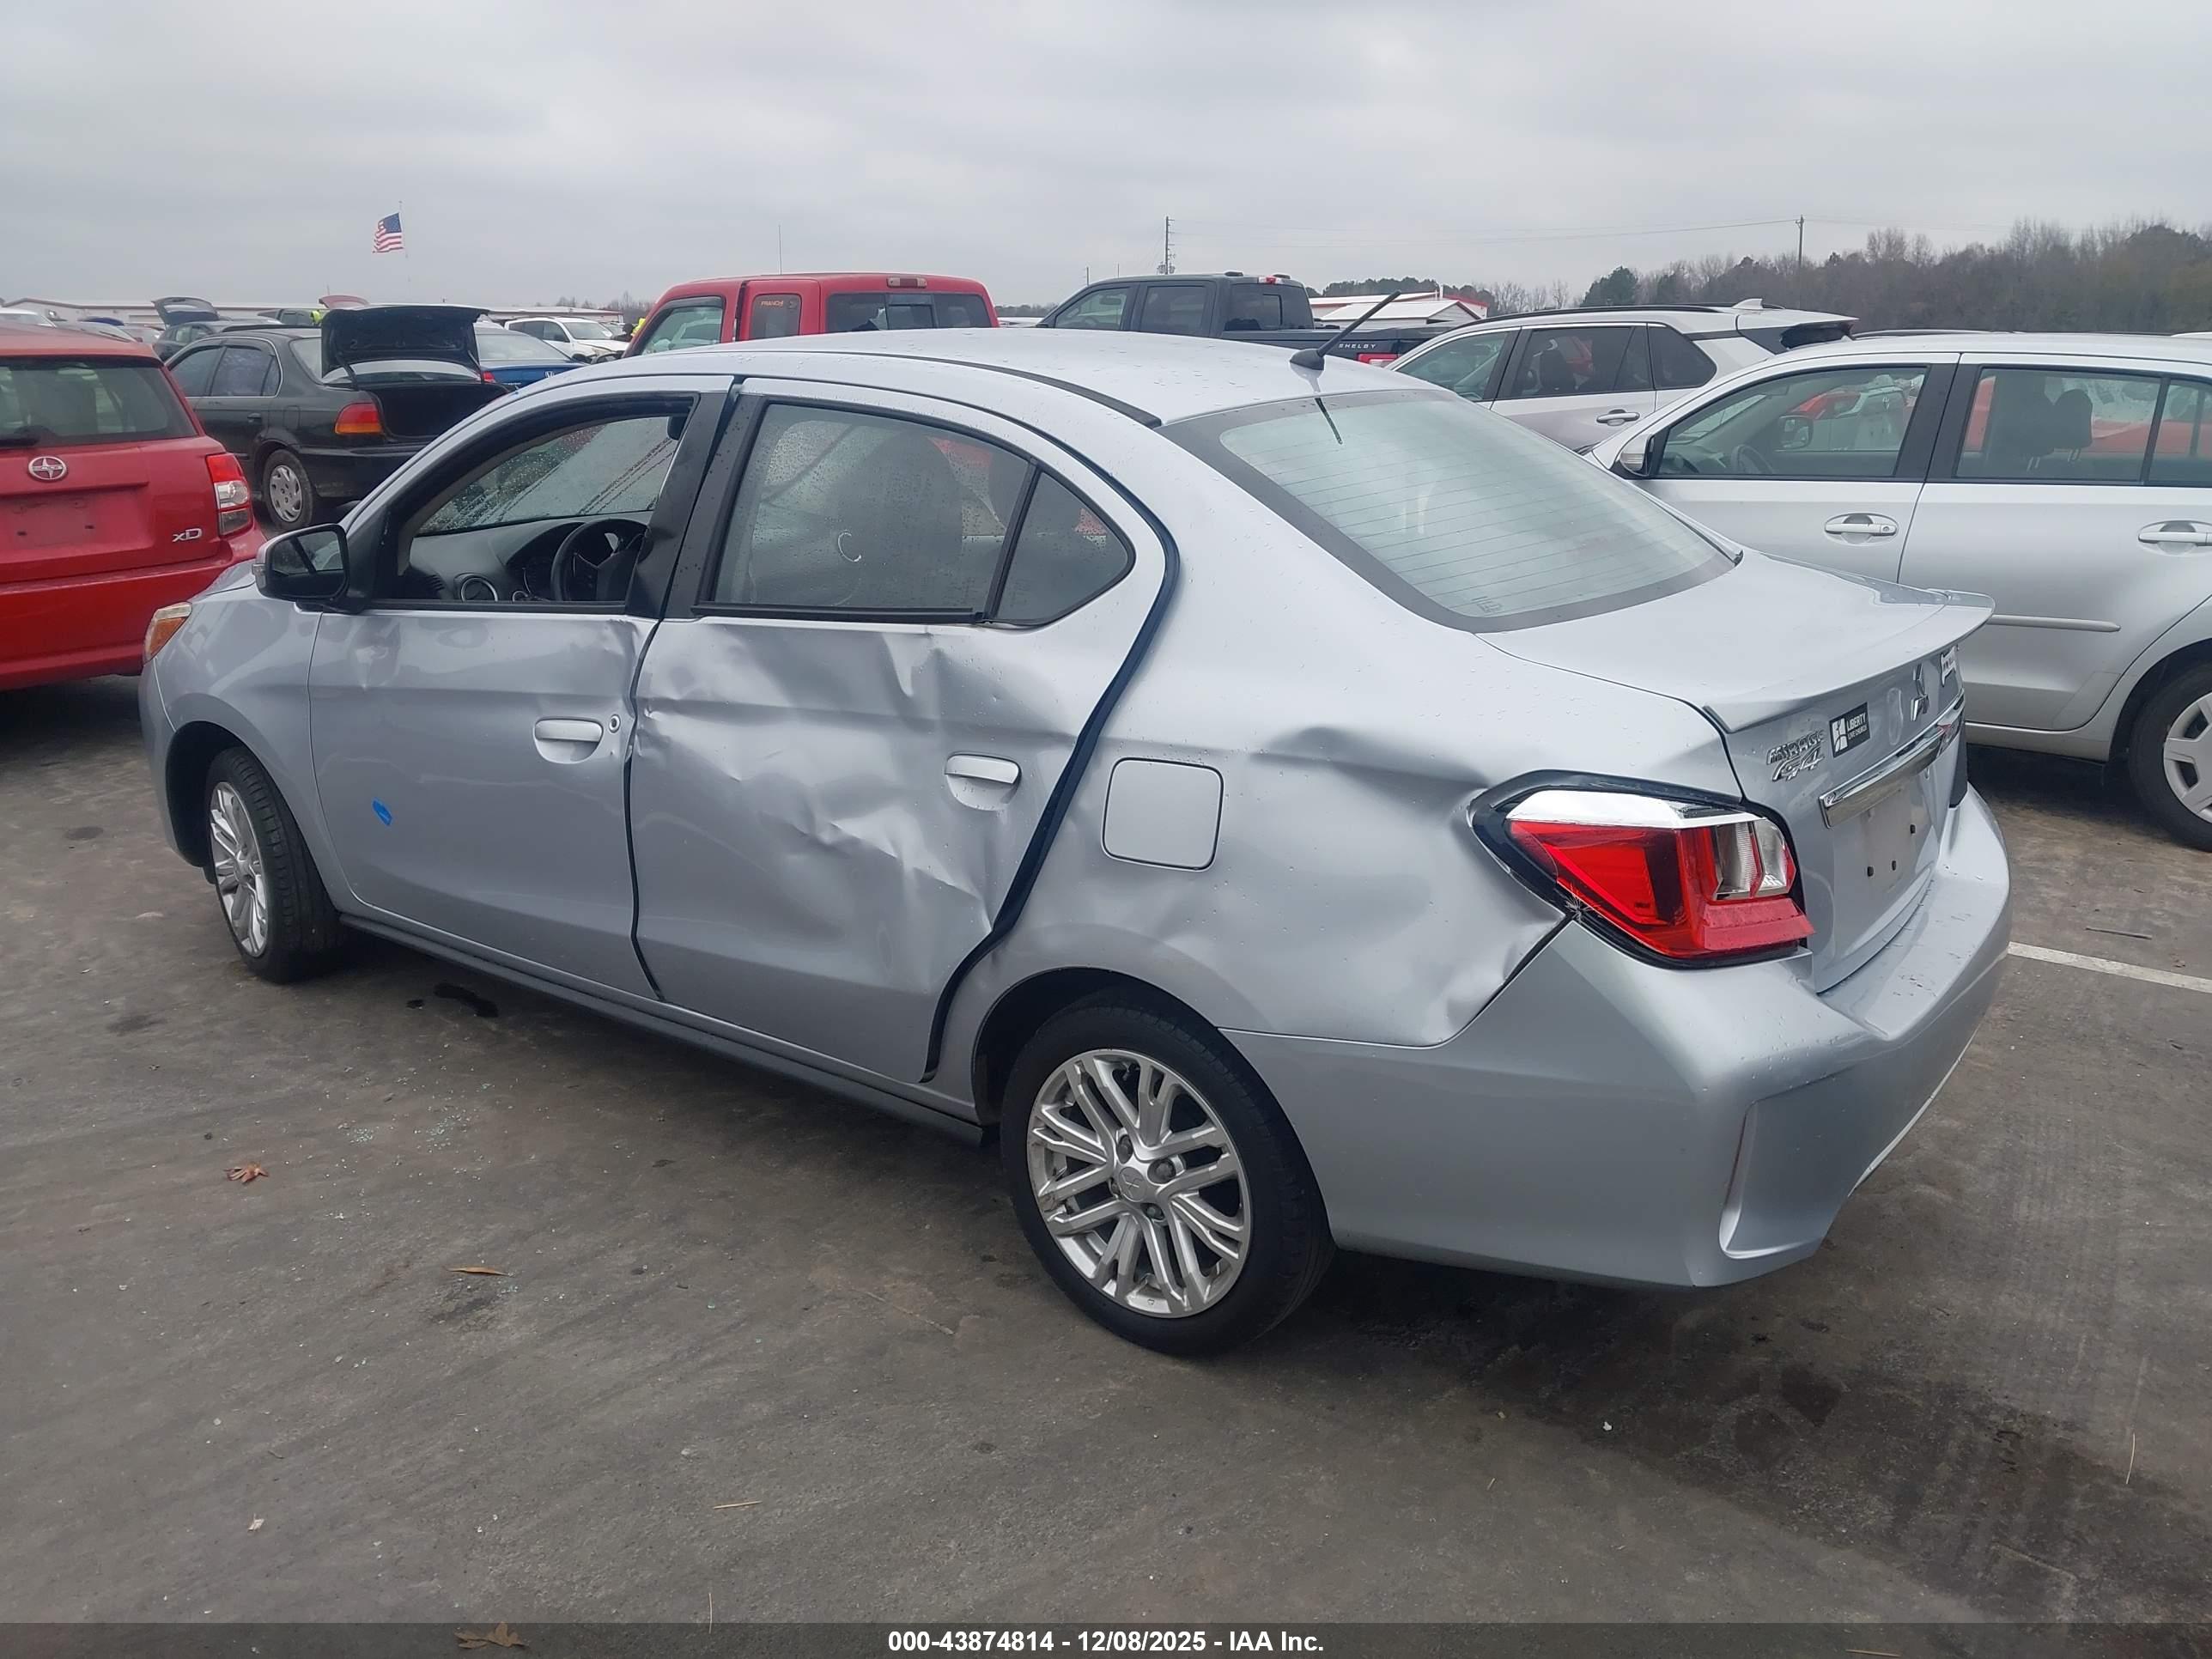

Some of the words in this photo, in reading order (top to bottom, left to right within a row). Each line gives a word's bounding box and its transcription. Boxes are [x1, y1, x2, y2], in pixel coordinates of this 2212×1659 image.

[1846, 712, 1866, 732] LIBERTY
[1766, 729, 1825, 765] MIRAGE
[1771, 745, 1826, 782] G4
